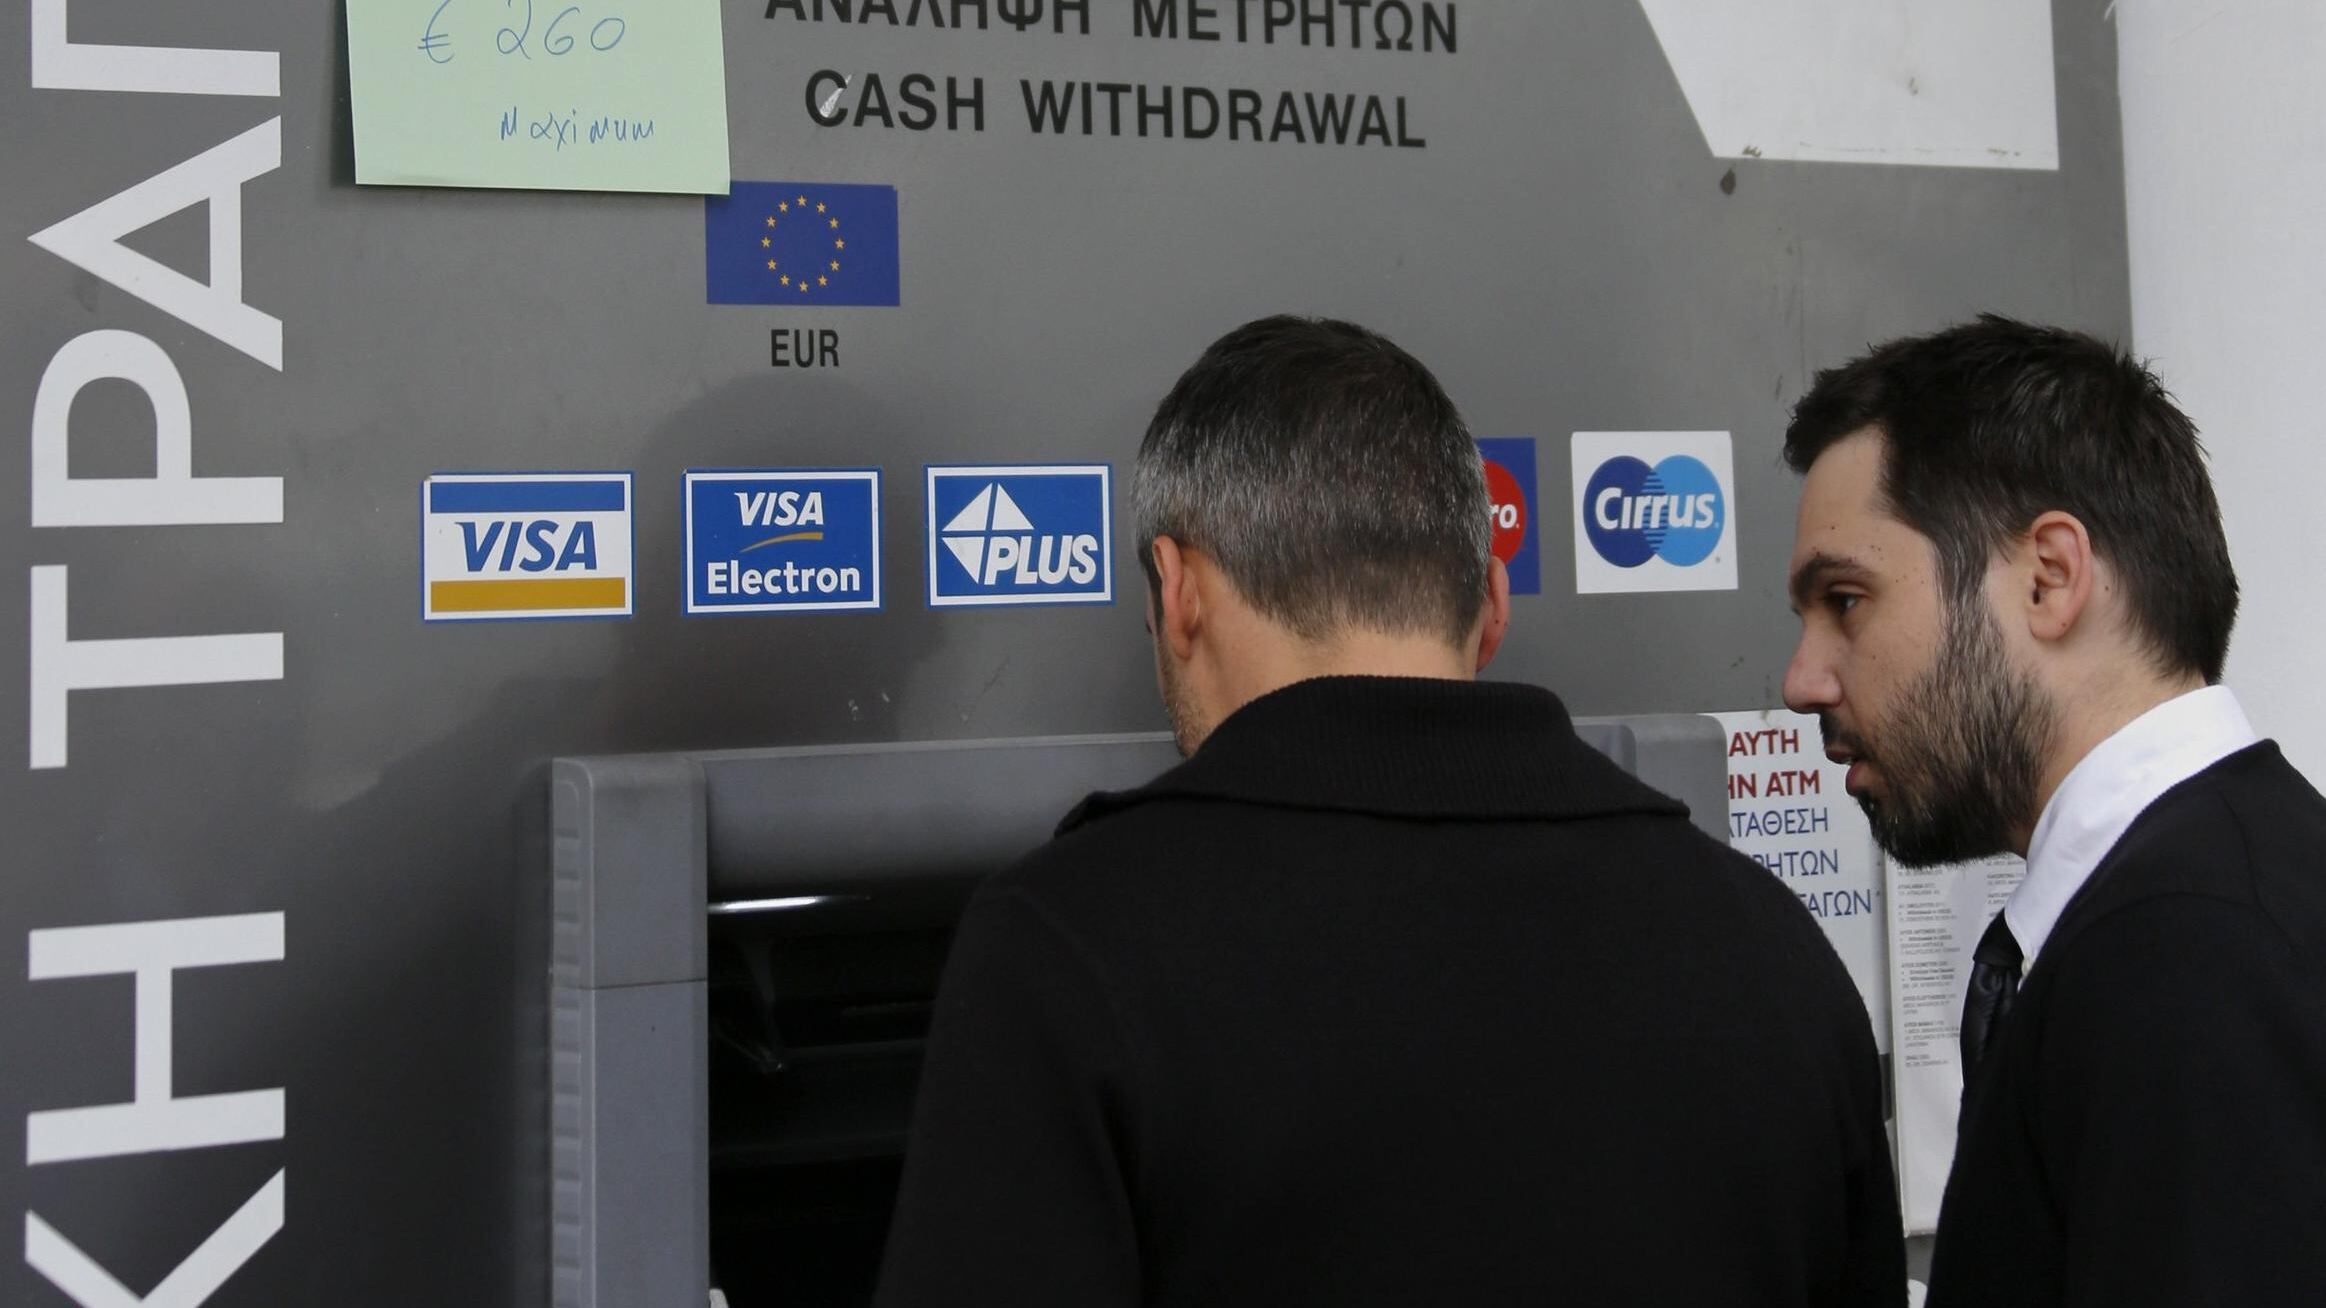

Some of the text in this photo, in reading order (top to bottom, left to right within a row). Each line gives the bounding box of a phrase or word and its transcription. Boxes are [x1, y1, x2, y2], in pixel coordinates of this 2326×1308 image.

[496, 0, 626, 60] 260
[805, 69, 1427, 149] CASH WITHDRAWAL
[770, 328, 840, 369] EUR
[735, 490, 825, 527] VISA
[1595, 486, 1716, 530] Cirrus
[454, 519, 598, 573] VISA
[984, 534, 1099, 586] PLUS
[707, 559, 861, 595] Electron
[1728, 728, 1800, 757] ΑΥΤΗ
[1765, 769, 1821, 797] ATM
[1797, 888, 1873, 918] ΑΓΩΝ
